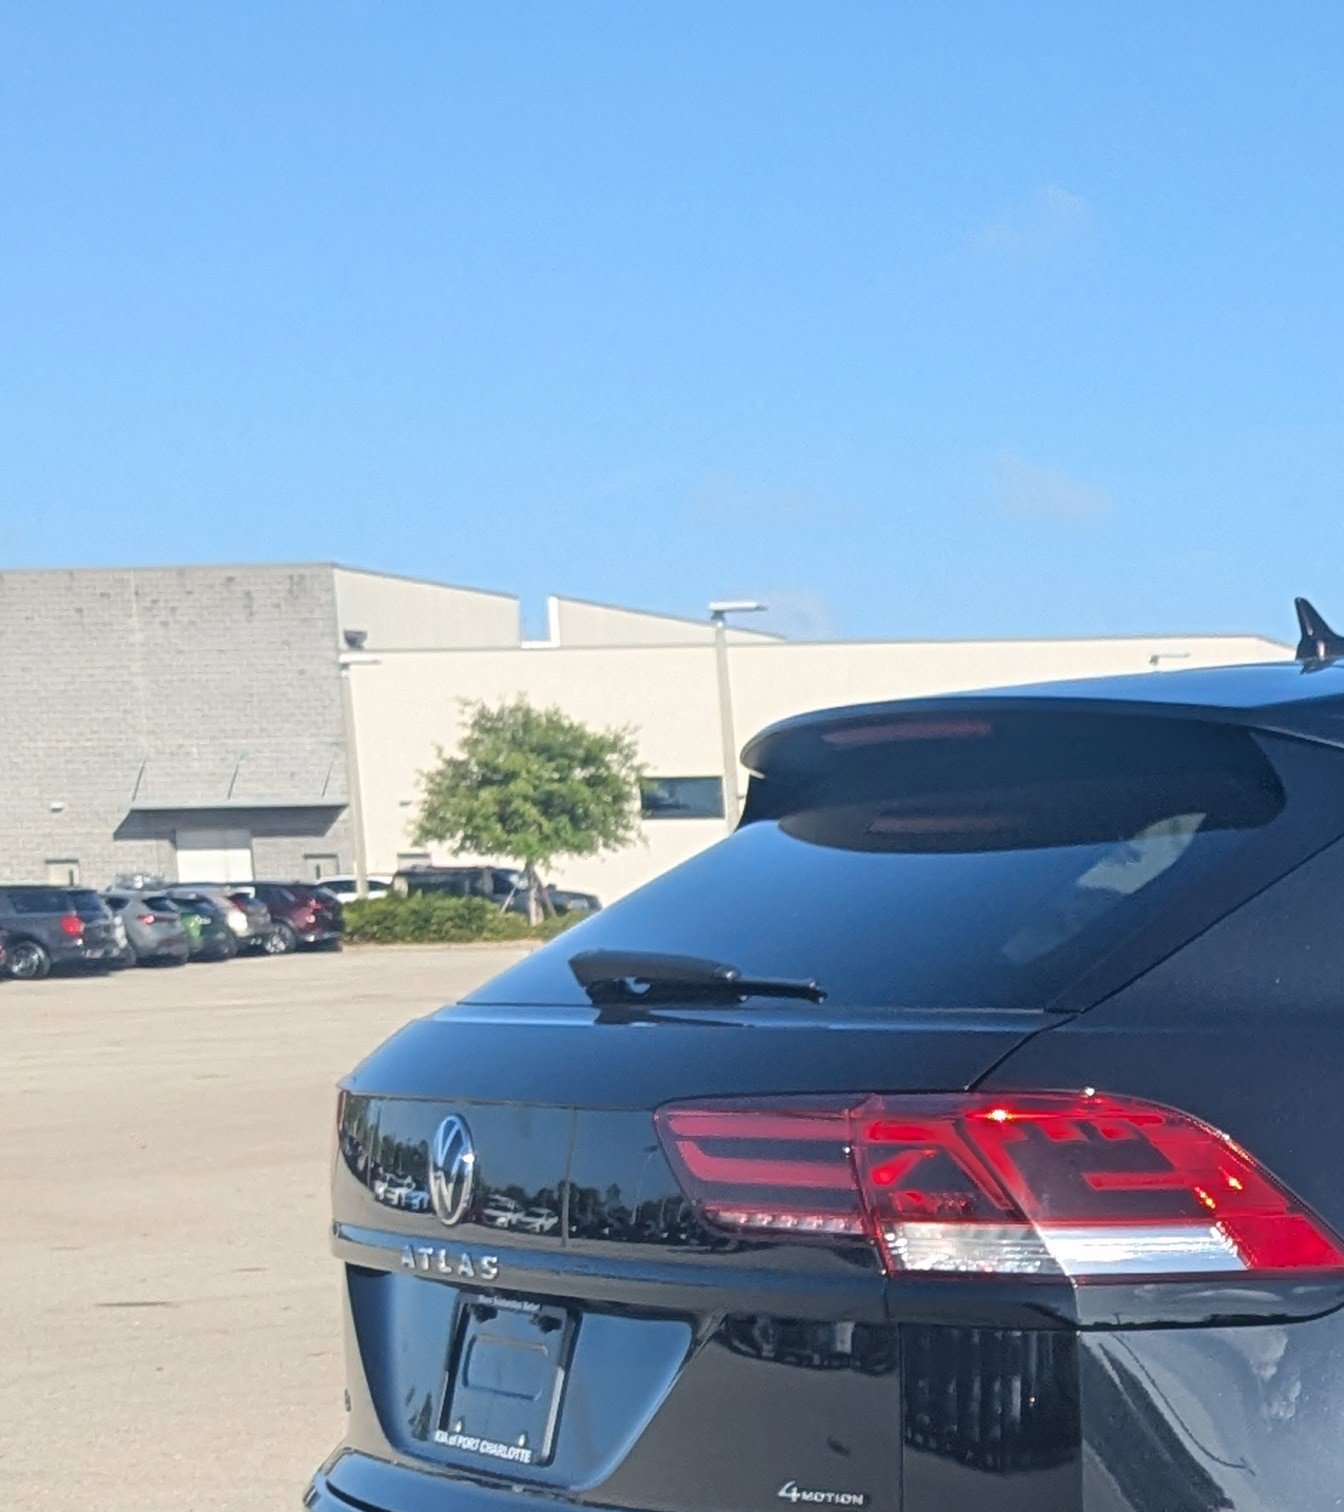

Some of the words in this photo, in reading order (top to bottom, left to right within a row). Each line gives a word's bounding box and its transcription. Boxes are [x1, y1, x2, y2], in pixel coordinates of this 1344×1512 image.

[401, 1244, 498, 1280] ATLAS
[480, 1440, 532, 1464] CHARLOTTE
[778, 1480, 864, 1505] 4MOTION
